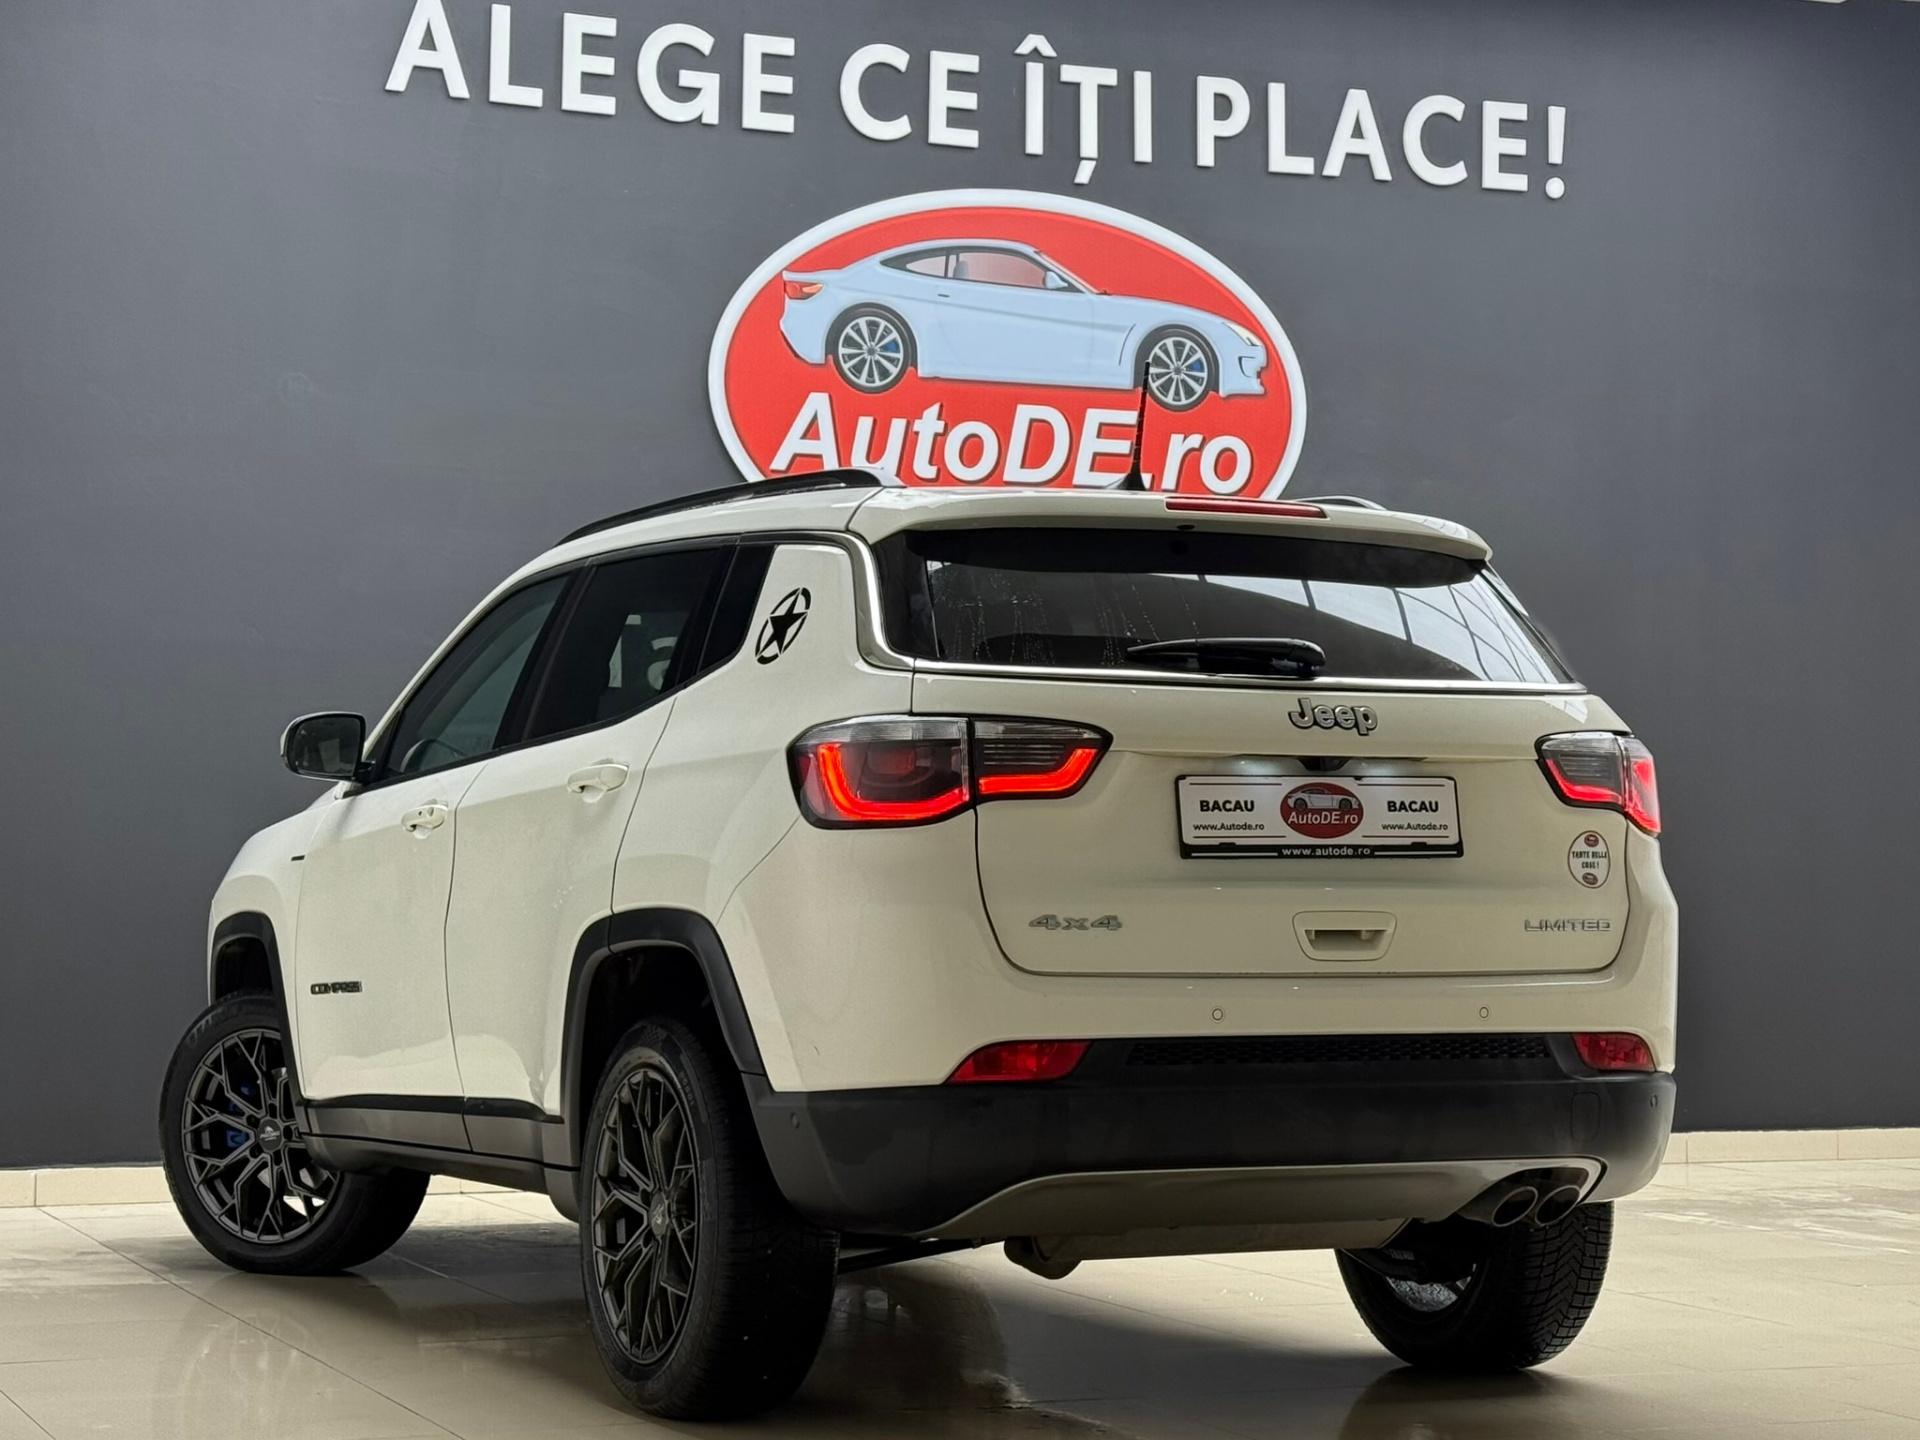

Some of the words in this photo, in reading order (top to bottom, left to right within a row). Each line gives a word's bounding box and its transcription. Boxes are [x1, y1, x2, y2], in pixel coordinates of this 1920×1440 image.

[384, 0, 796, 133] ALEGE
[840, 43, 981, 148] CE
[1196, 75, 1567, 199] PLACE!
[769, 392, 1253, 494] AutoDE.ro
[1288, 697, 1378, 736] Jeep
[1200, 799, 1255, 812] BACAU
[1387, 800, 1439, 813] BACAU
[1287, 811, 1359, 825] AutoDE.ro
[1193, 821, 1265, 831] www.Autode.ro
[1381, 821, 1449, 831] www.Autode.ro
[1281, 847, 1371, 857] www.autode.ro
[1524, 919, 1611, 932] LIMITED
